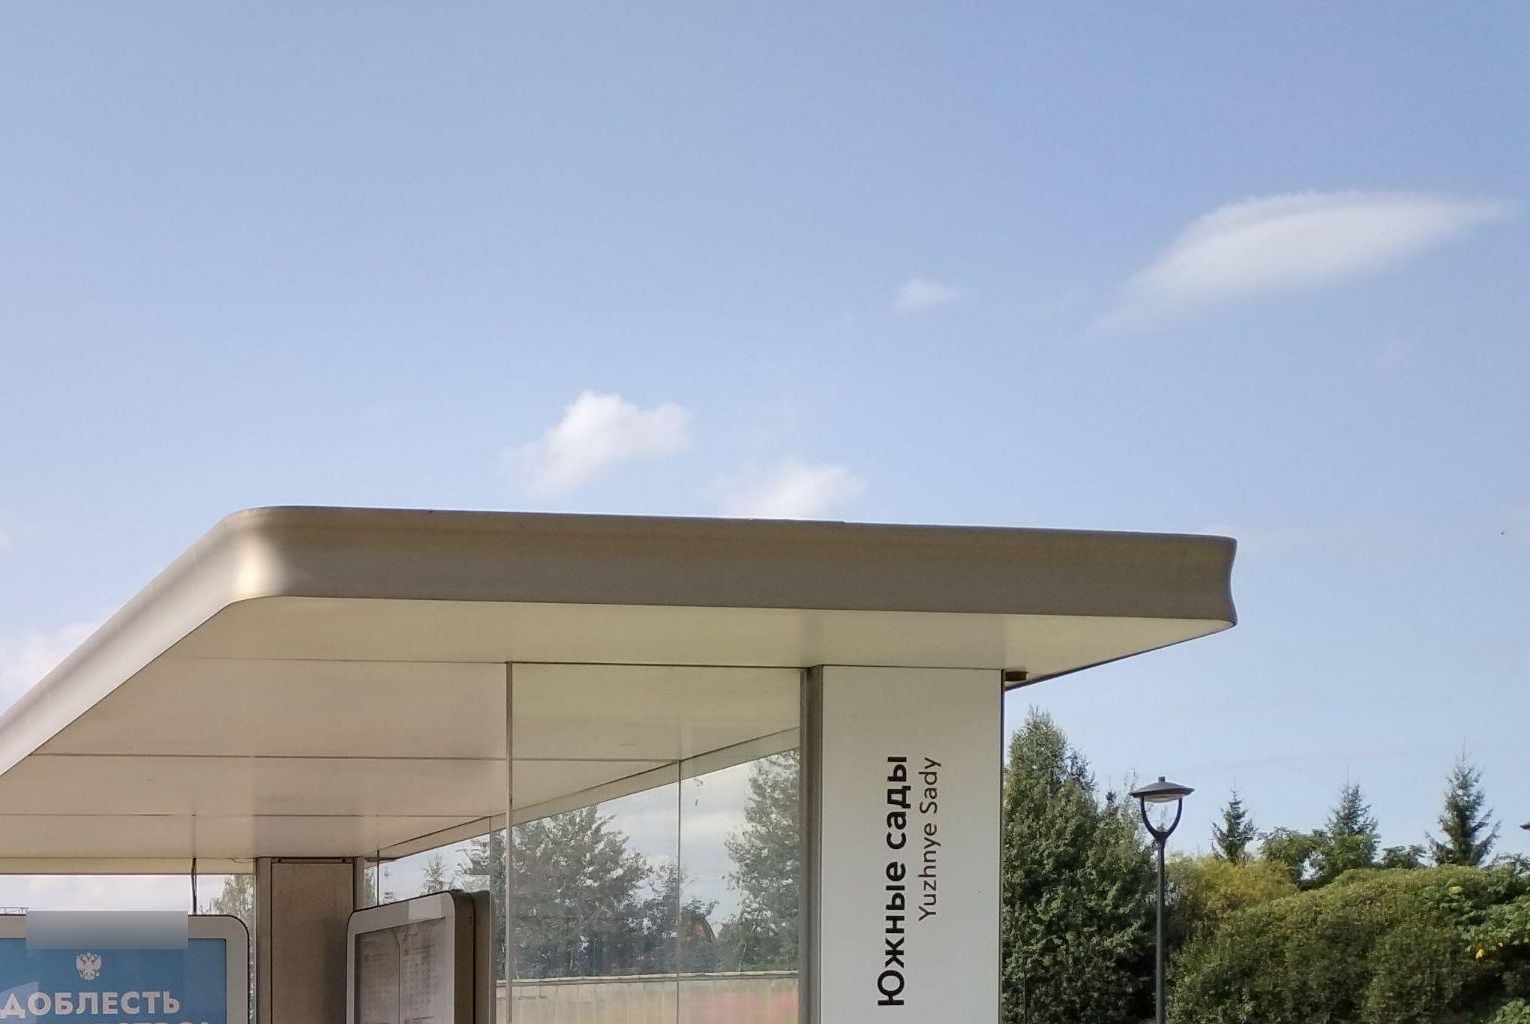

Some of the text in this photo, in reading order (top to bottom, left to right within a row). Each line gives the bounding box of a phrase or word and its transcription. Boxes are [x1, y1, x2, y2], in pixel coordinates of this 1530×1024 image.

[877, 756, 911, 1006] Южные сады
[918, 757, 942, 922] Yuzhnye Sady
[0, 991, 181, 1019] ДОБЛЕСТЬ
